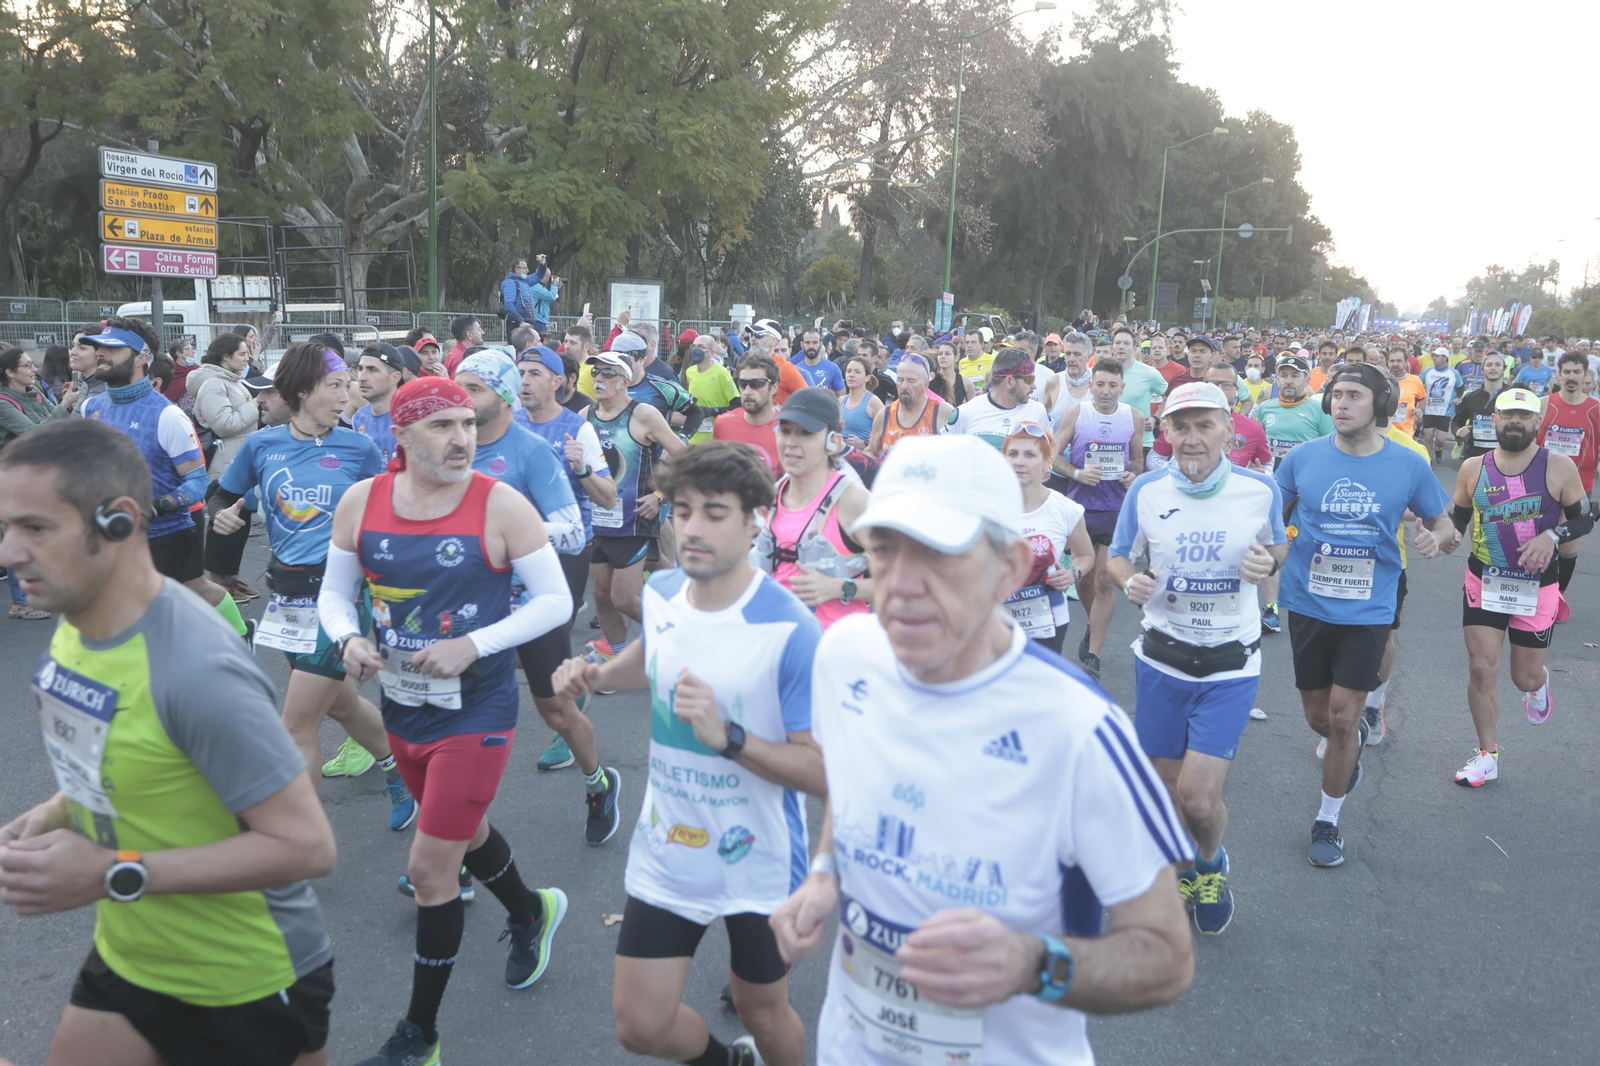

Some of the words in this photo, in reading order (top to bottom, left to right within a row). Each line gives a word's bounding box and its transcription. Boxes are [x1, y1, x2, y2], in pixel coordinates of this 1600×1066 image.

[106, 152, 138, 163] hospital
[107, 162, 137, 175] Virgen
[141, 168, 155, 178] del
[107, 187, 139, 197] estación
[143, 189, 168, 200] Prado
[108, 196, 125, 206] San
[131, 199, 175, 212] Sebastián
[185, 225, 214, 234] estación
[140, 231, 165, 242] Plaza
[170, 234, 181, 243] de
[186, 235, 214, 245] Armas
[156, 252, 182, 263] Caixa
[187, 254, 214, 264] Forum
[154, 263, 179, 273] Torre
[184, 264, 213, 275] Sevilla
[280, 484, 330, 503] Snell
[1338, 488, 1376, 501] Siempre
[1321, 503, 1381, 513] FUERTE
[1175, 531, 1226, 545] +QUE
[1175, 545, 1224, 563] 10K
[1333, 547, 1369, 556] ZURICH
[1332, 564, 1353, 573] 9923
[1190, 581, 1232, 591] ZURICH
[1312, 574, 1343, 585] SIEMPRE
[1344, 578, 1371, 586] FUERTE
[1500, 583, 1519, 592] 8635
[1012, 607, 1031, 618] 9172
[1190, 602, 1215, 612] 9207
[1191, 618, 1213, 627] PAUL
[398, 636, 438, 649] ZURIC
[401, 679, 430, 691] DUQUE
[52, 673, 107, 712] ZURICH
[651, 758, 740, 789] ATLETISMO
[877, 1006, 918, 1032] JOSÉ
